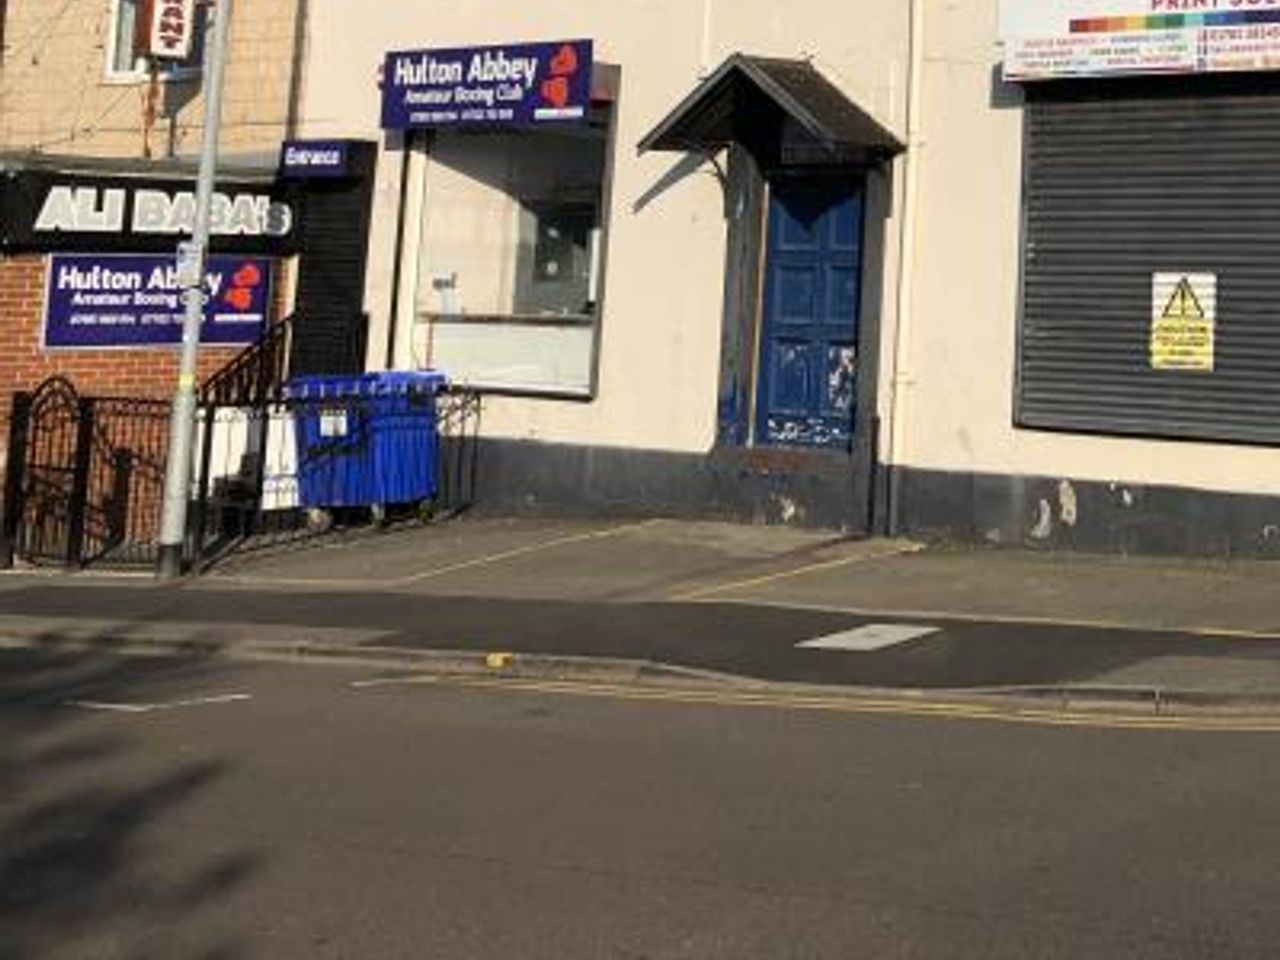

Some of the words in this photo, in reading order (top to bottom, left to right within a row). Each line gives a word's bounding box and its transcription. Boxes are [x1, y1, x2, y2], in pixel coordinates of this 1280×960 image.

[394, 54, 463, 85] Hulton
[467, 51, 538, 88] Abbey
[496, 84, 523, 101] Club
[285, 146, 340, 165] Entrance
[34, 186, 126, 233] ALI
[58, 266, 141, 290] Hulton
[147, 265, 223, 296] Aby
[134, 292, 178, 309] Boxing
